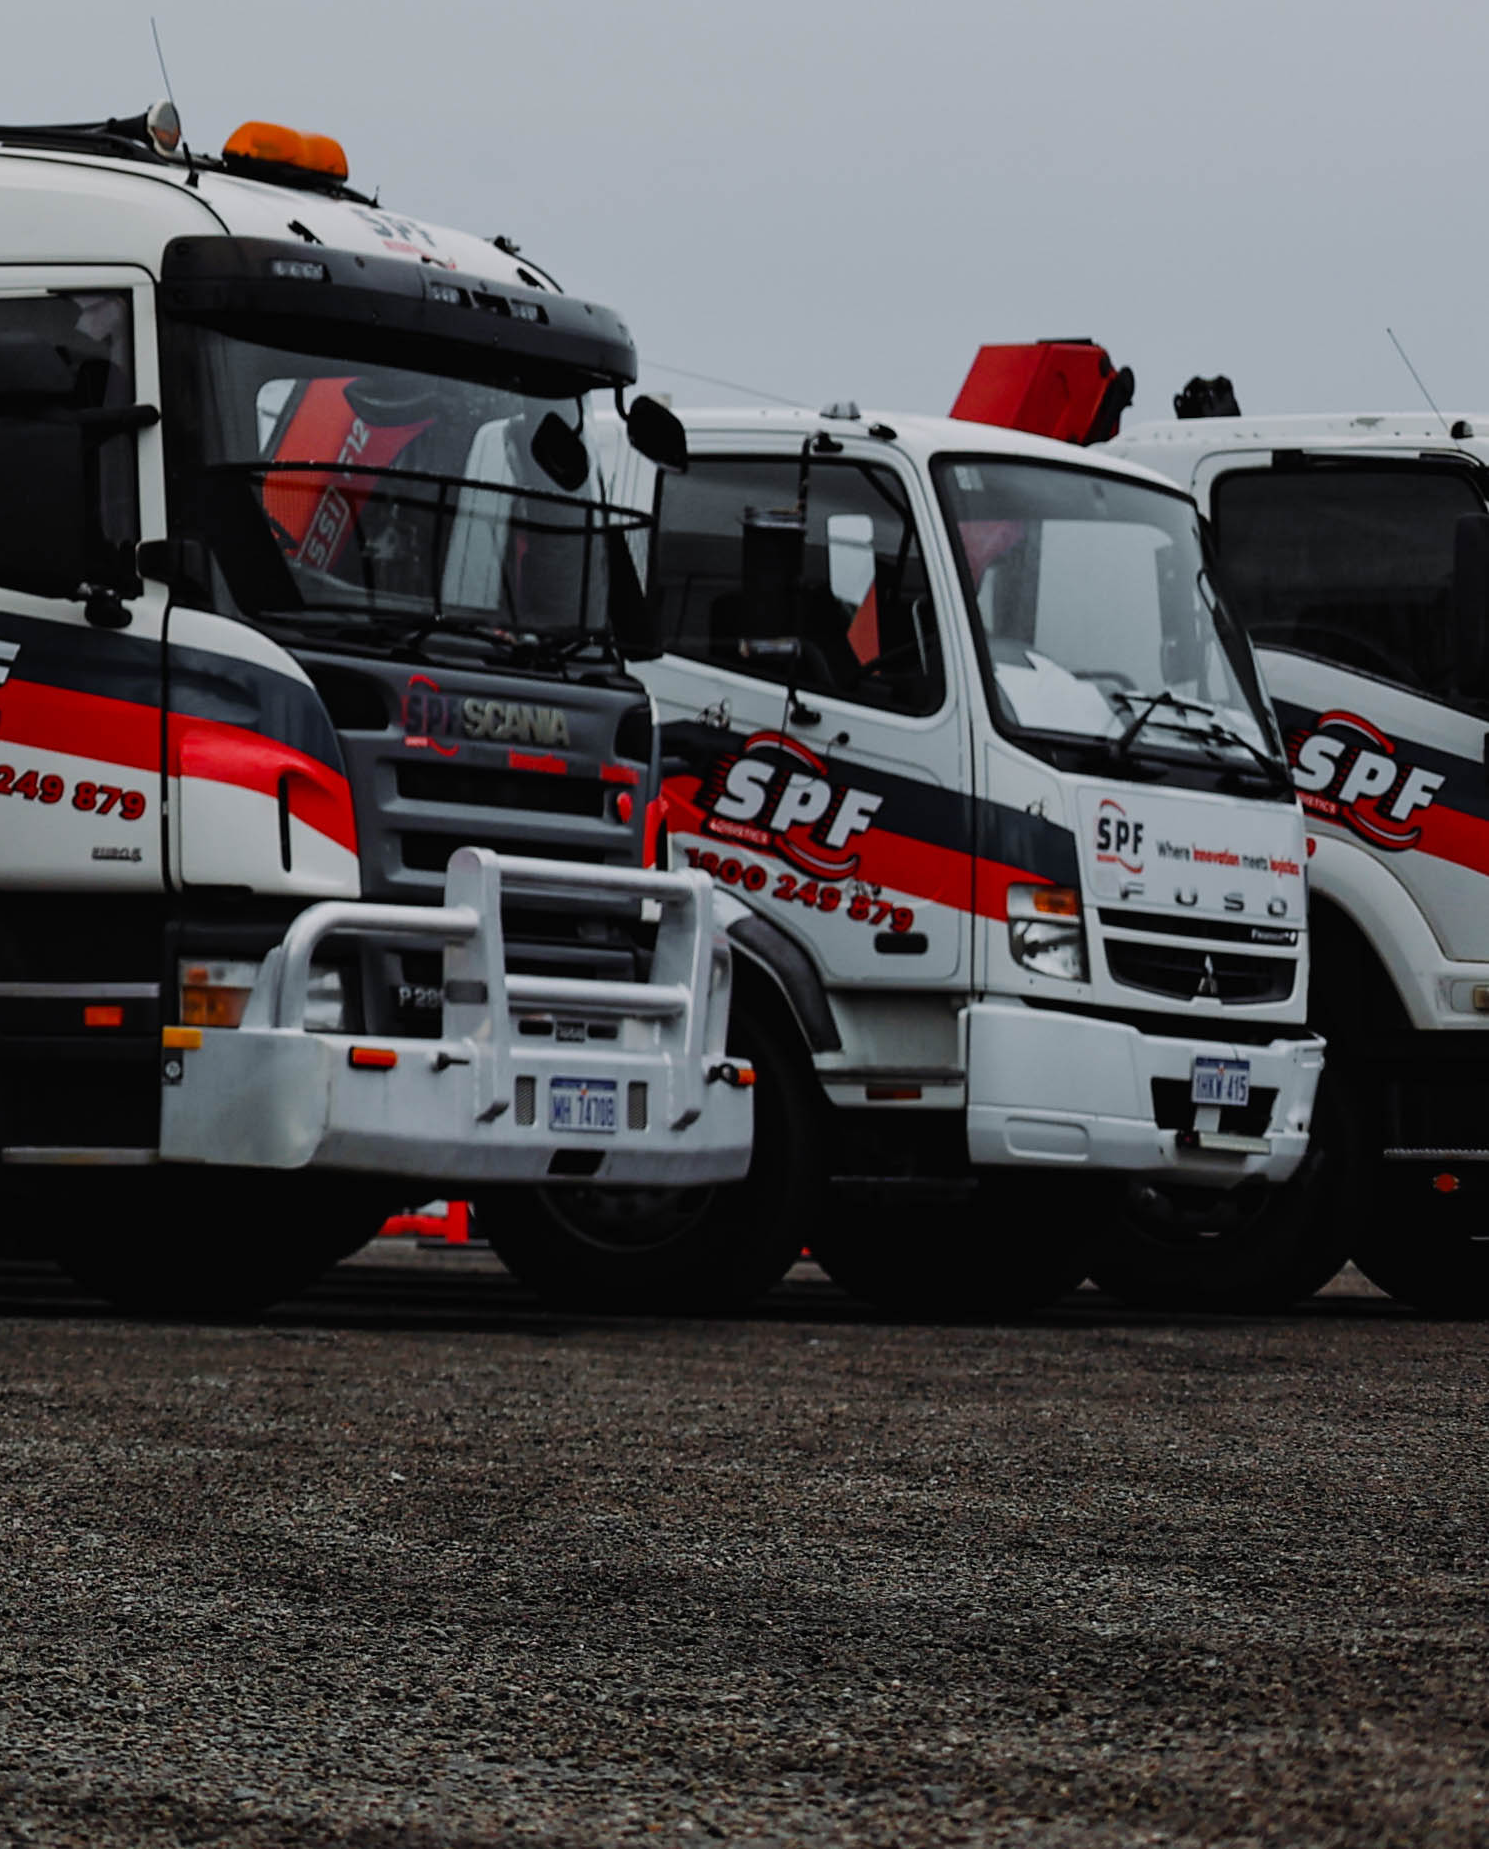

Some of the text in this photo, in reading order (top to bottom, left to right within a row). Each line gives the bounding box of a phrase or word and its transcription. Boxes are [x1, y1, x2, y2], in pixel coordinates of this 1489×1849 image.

[463, 698, 570, 748] SCANIA
[72, 781, 146, 820] 879
[1291, 735, 1445, 821] SPF
[713, 758, 883, 849] SPF
[1097, 818, 1143, 854] SPF
[772, 873, 842, 913] 249
[847, 895, 914, 933] 879
[1120, 881, 1288, 917] FUSO
